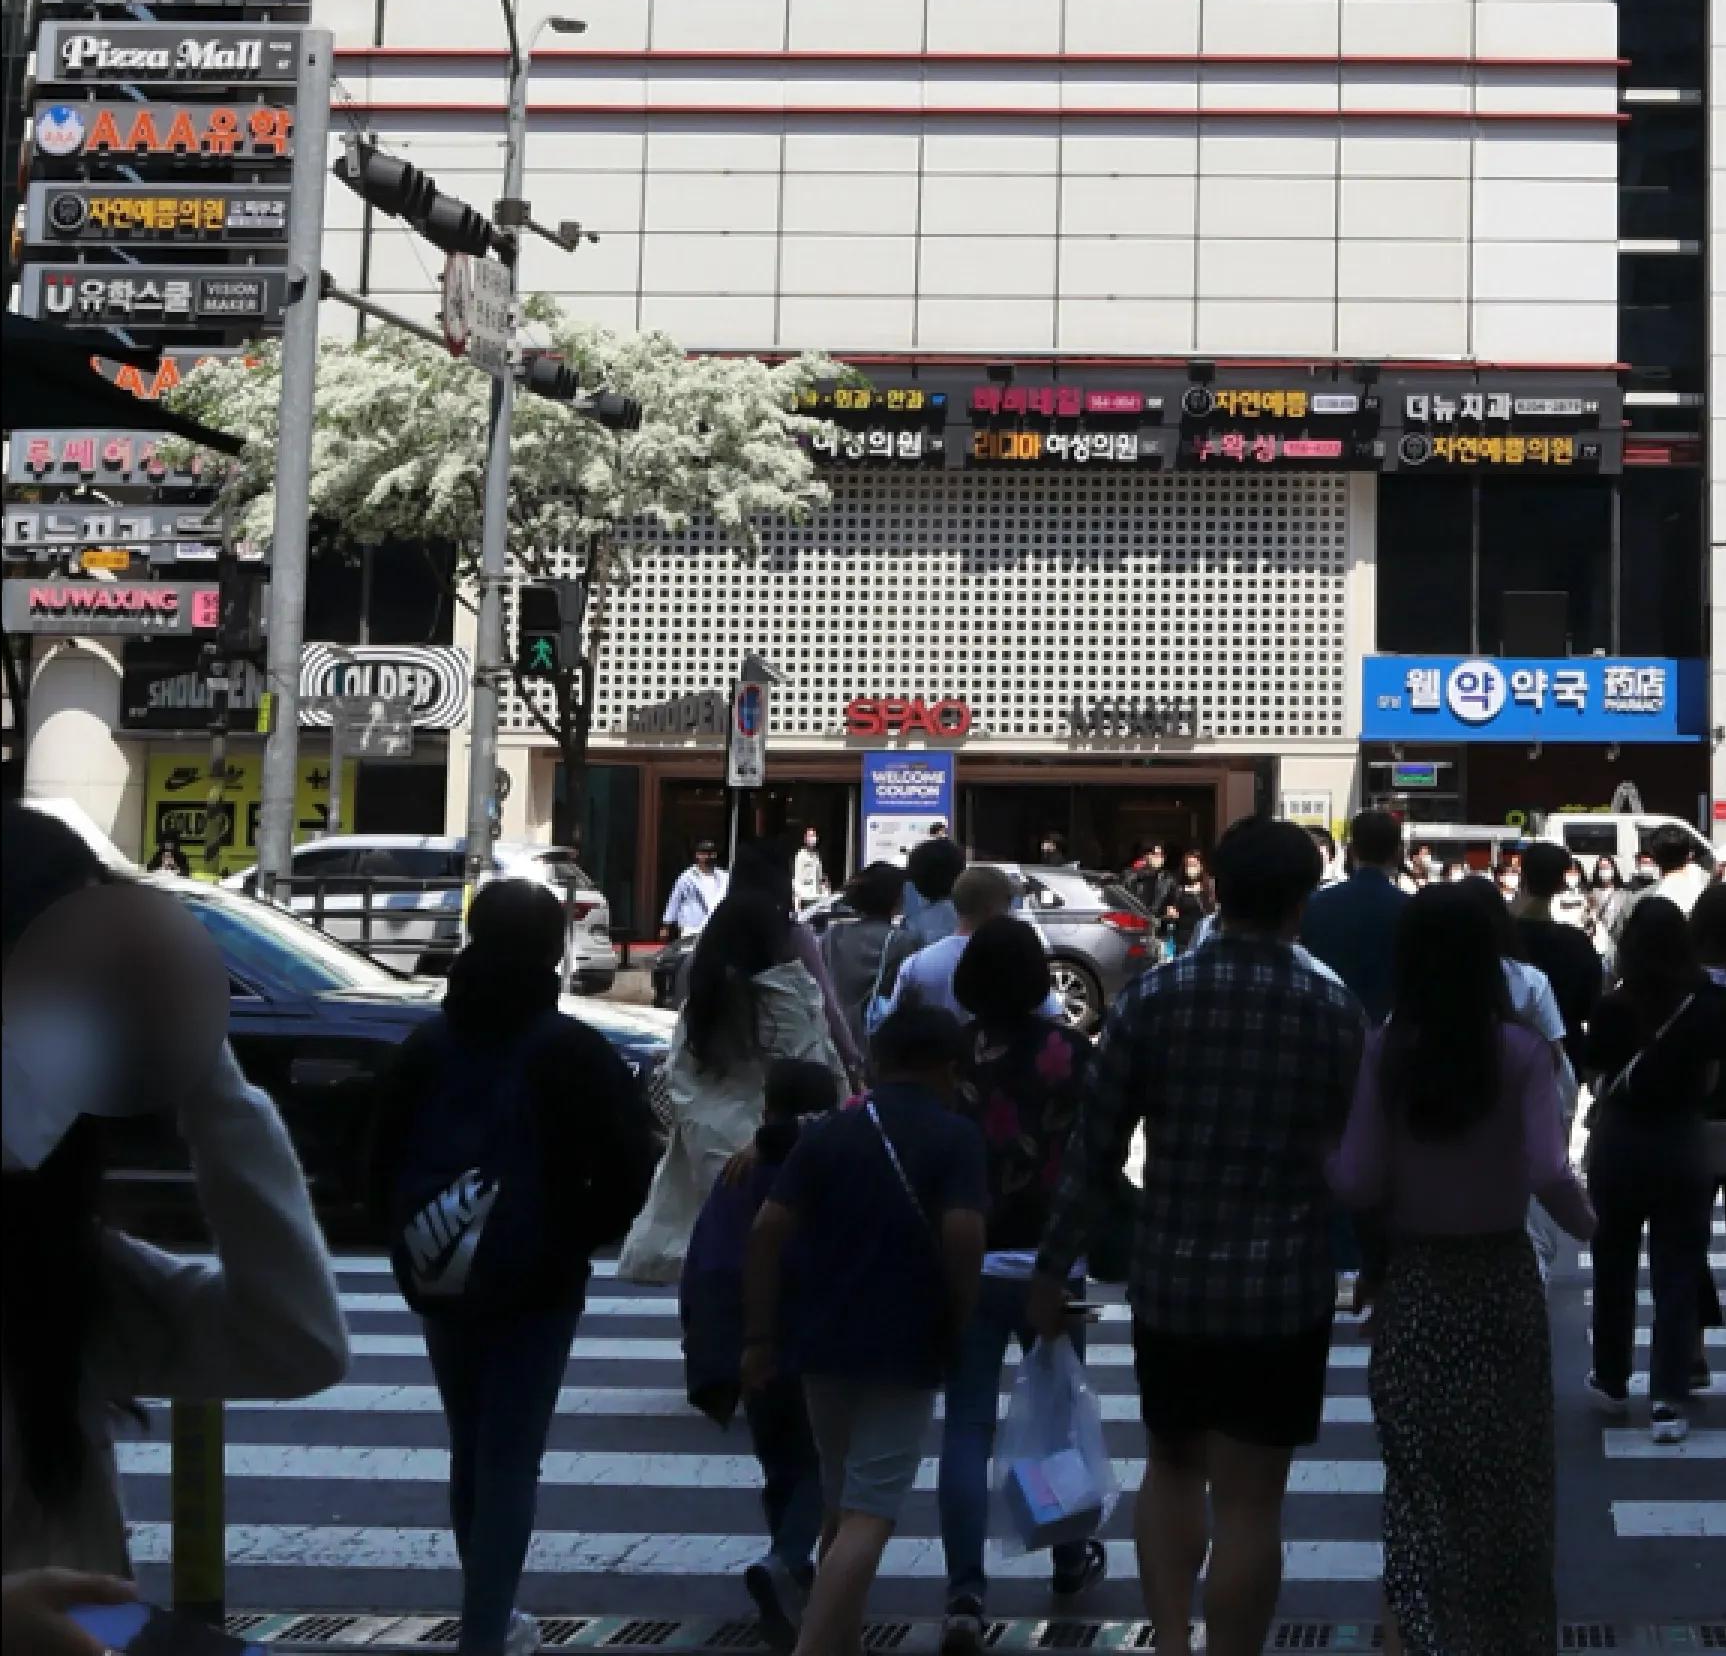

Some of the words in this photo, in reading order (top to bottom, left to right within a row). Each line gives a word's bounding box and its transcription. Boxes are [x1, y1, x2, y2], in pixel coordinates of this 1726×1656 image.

[62, 35, 169, 67] Pizza
[175, 38, 263, 69] Mall
[1406, 392, 1512, 423] 더뉴치과
[812, 426, 923, 459] 여성의원
[974, 432, 1042, 460] 리디아
[1046, 432, 1139, 463] 여성의원
[29, 587, 180, 610] NUWAXING
[846, 698, 971, 738] SPAO
[872, 771, 946, 784] WELCOME
[876, 786, 940, 799] COUPON
[402, 1166, 484, 1275] NIKE
